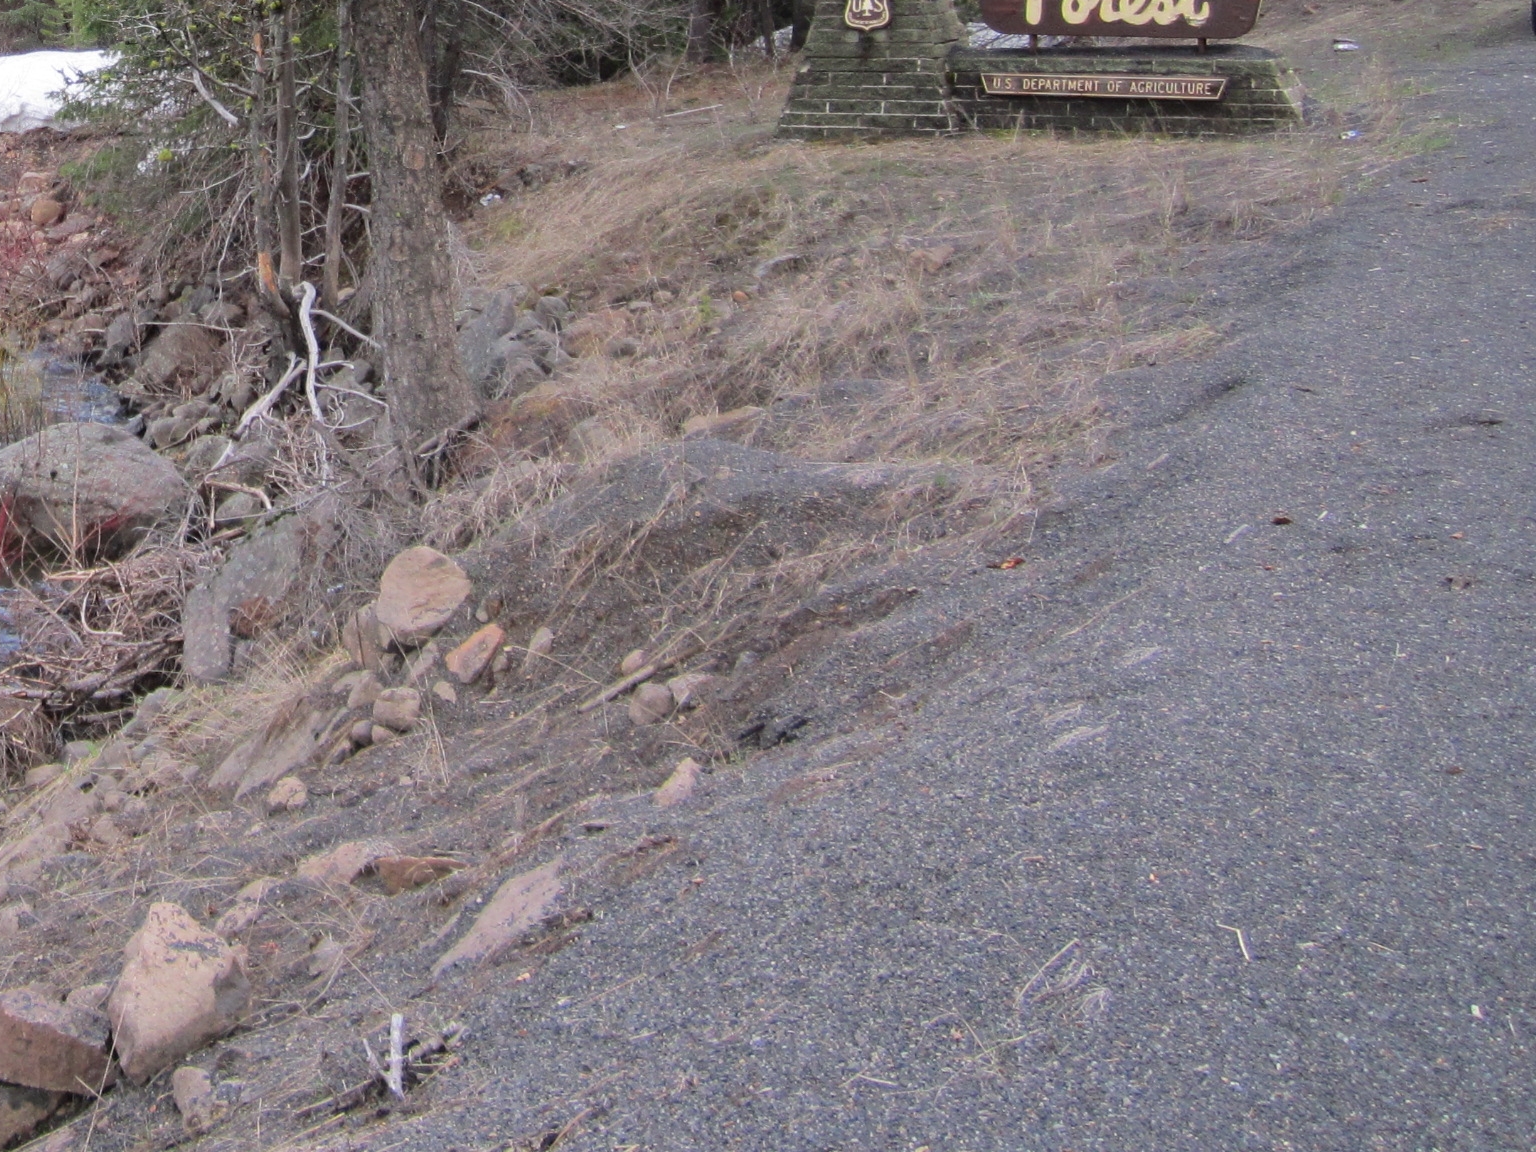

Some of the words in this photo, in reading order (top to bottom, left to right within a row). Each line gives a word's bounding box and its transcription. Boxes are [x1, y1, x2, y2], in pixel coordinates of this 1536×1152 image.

[1022, 78, 1100, 91] DEPARTMENT
[1107, 80, 1123, 92] OF
[1129, 81, 1212, 95] AGRICULTURE
